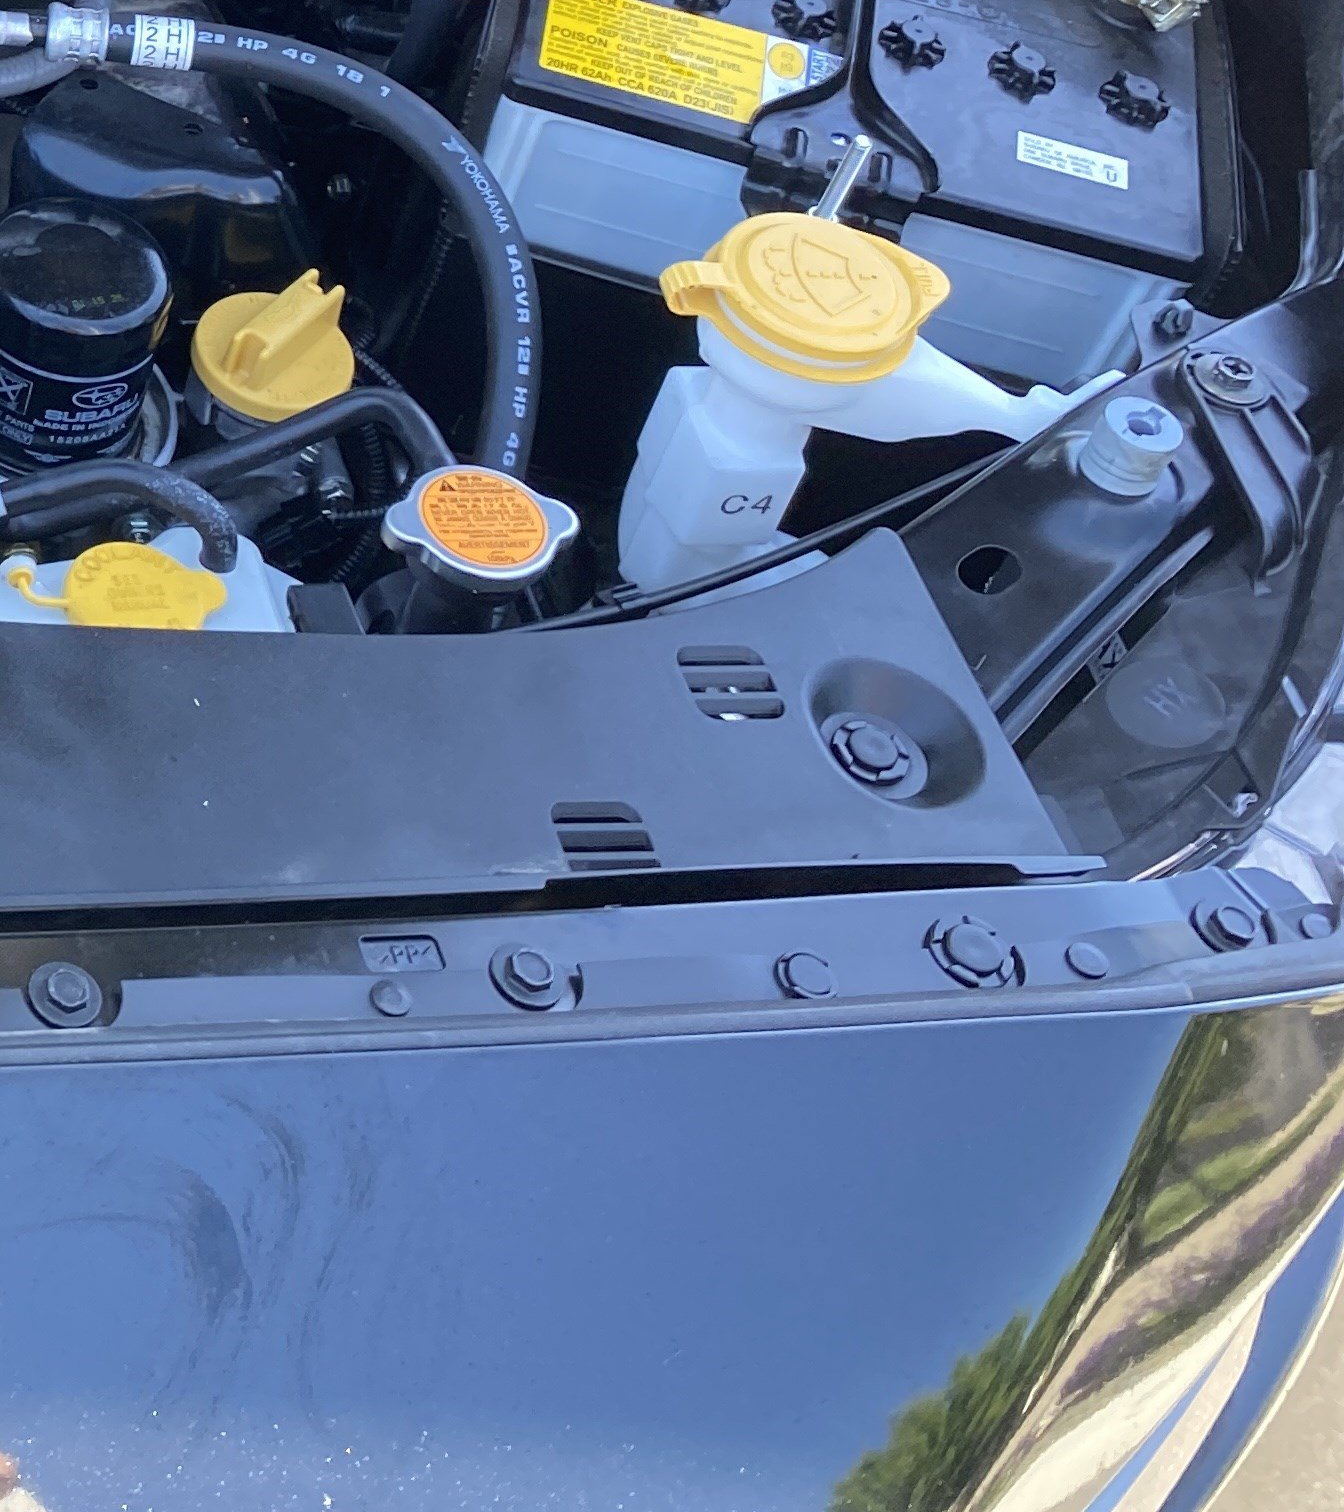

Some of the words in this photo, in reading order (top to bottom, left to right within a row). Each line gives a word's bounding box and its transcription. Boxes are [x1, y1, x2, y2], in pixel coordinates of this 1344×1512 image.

[145, 26, 159, 43] 2
[167, 28, 183, 45] H
[550, 25, 608, 49] POISON
[143, 44, 157, 61] 2
[164, 45, 181, 62] H
[236, 36, 269, 51] HP
[281, 47, 318, 65] 4G
[336, 63, 365, 84] 18
[380, 85, 391, 98] 1
[546, 57, 579, 75] 20HR
[581, 66, 612, 83] 62Ah
[618, 77, 645, 93] CCA
[648, 84, 678, 102] 620A
[460, 154, 511, 234] YOKOHAMA
[44, 392, 140, 423] SUBARU
[512, 385, 528, 419] HP
[4, 414, 35, 432] PARTS
[502, 431, 520, 467] 4G
[720, 494, 773, 515] C4
